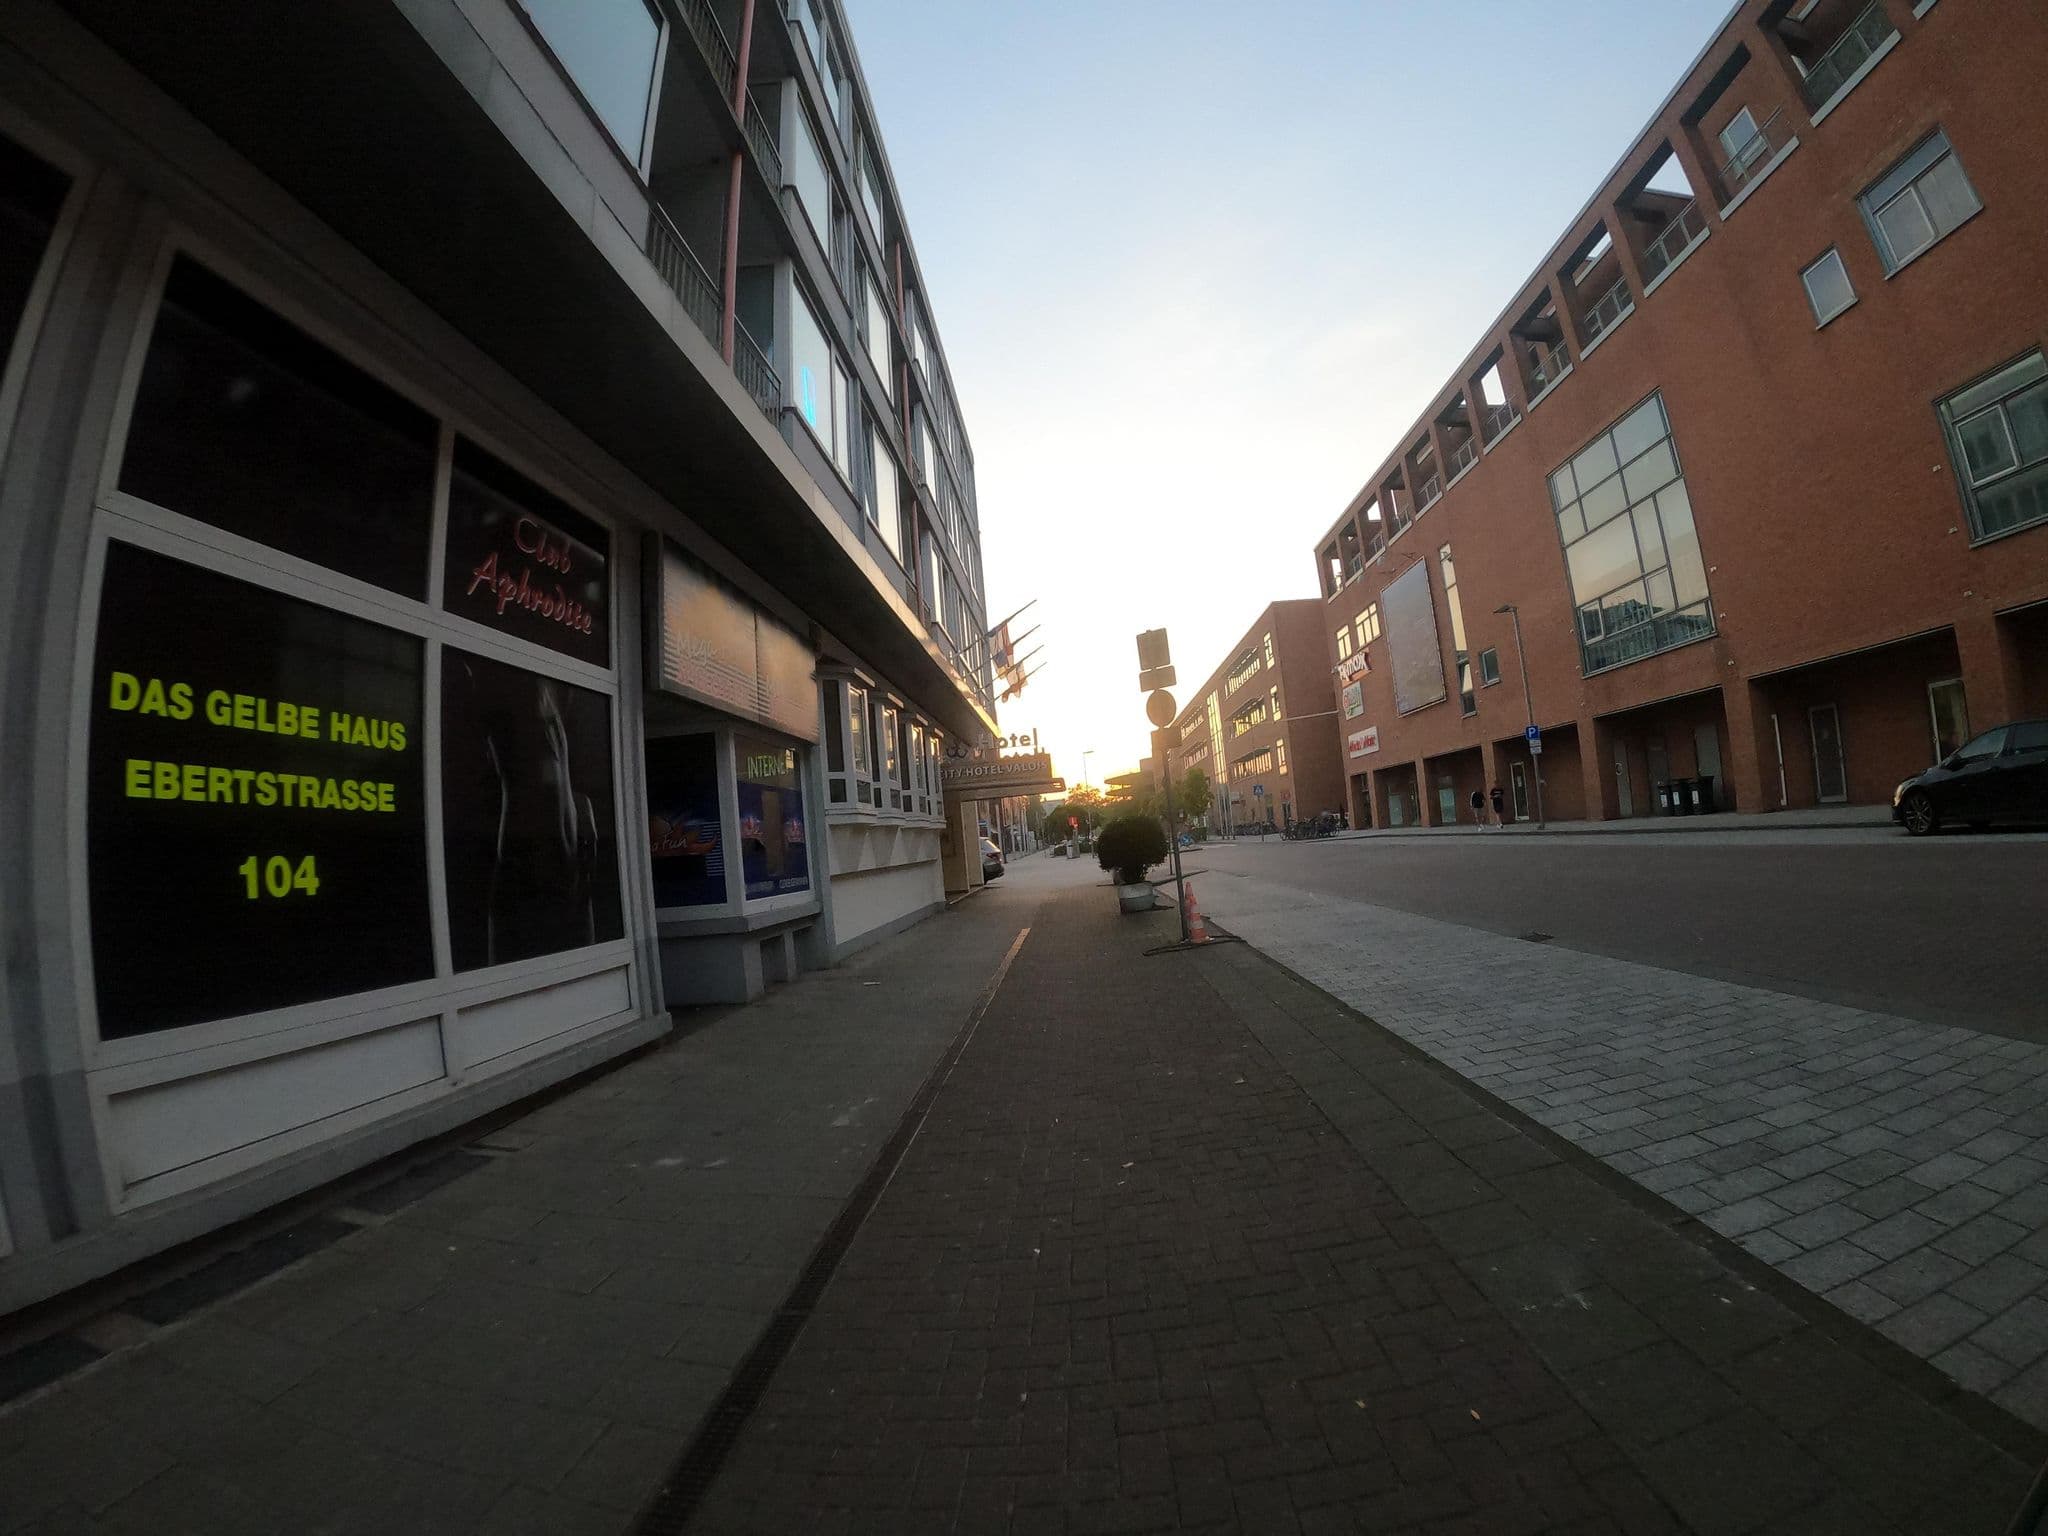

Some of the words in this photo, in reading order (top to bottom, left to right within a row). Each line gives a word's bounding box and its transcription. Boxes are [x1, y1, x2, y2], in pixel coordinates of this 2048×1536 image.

[513, 517, 574, 575] Club
[466, 551, 593, 636] Aphrodite
[110, 671, 194, 721] DAS
[205, 690, 321, 739] GELBE
[329, 711, 407, 751] HAUS
[125, 758, 396, 812] EBERTSTRASSE
[747, 752, 793, 780] INTERNE
[966, 765, 1004, 777] HOTEL
[1007, 761, 1048, 774] VALOIS
[239, 855, 320, 899] 104
